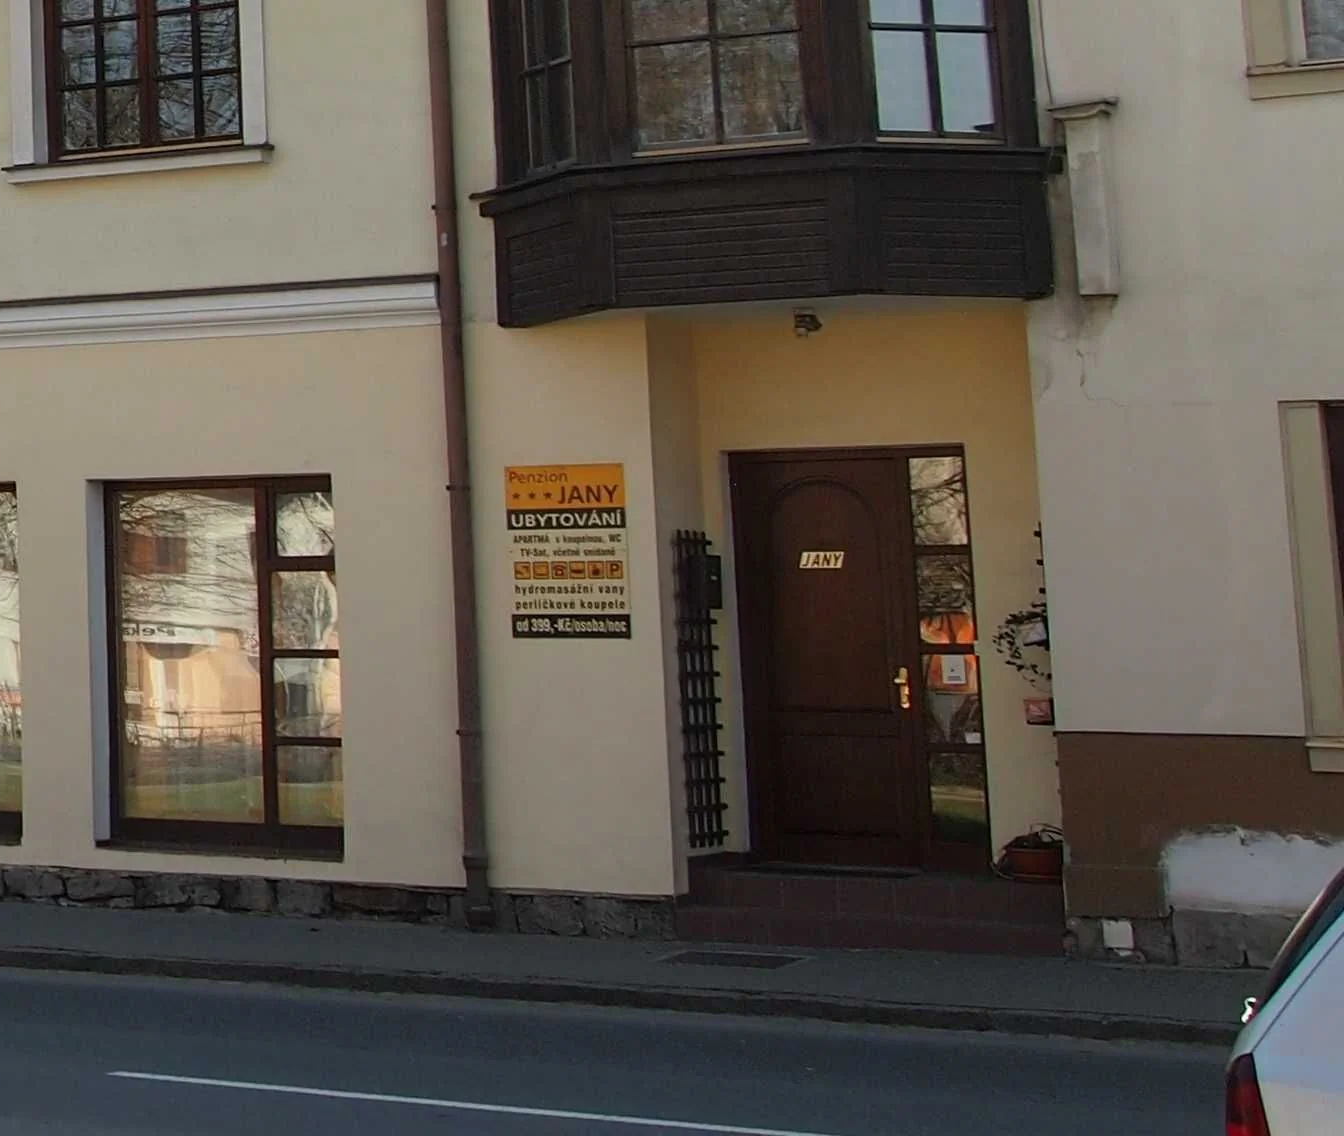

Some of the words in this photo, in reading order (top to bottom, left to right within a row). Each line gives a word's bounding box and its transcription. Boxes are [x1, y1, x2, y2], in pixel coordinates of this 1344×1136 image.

[509, 470, 568, 485] Penzion
[557, 484, 619, 505] JANY
[511, 509, 622, 528] UBYTOVÁNÍ
[608, 533, 622, 543] WC
[802, 553, 842, 567] JANY
[514, 583, 594, 597] hydromasážní
[598, 585, 625, 596] vany
[515, 598, 576, 611] perličkové
[579, 599, 626, 611] koupele
[516, 619, 529, 632] od
